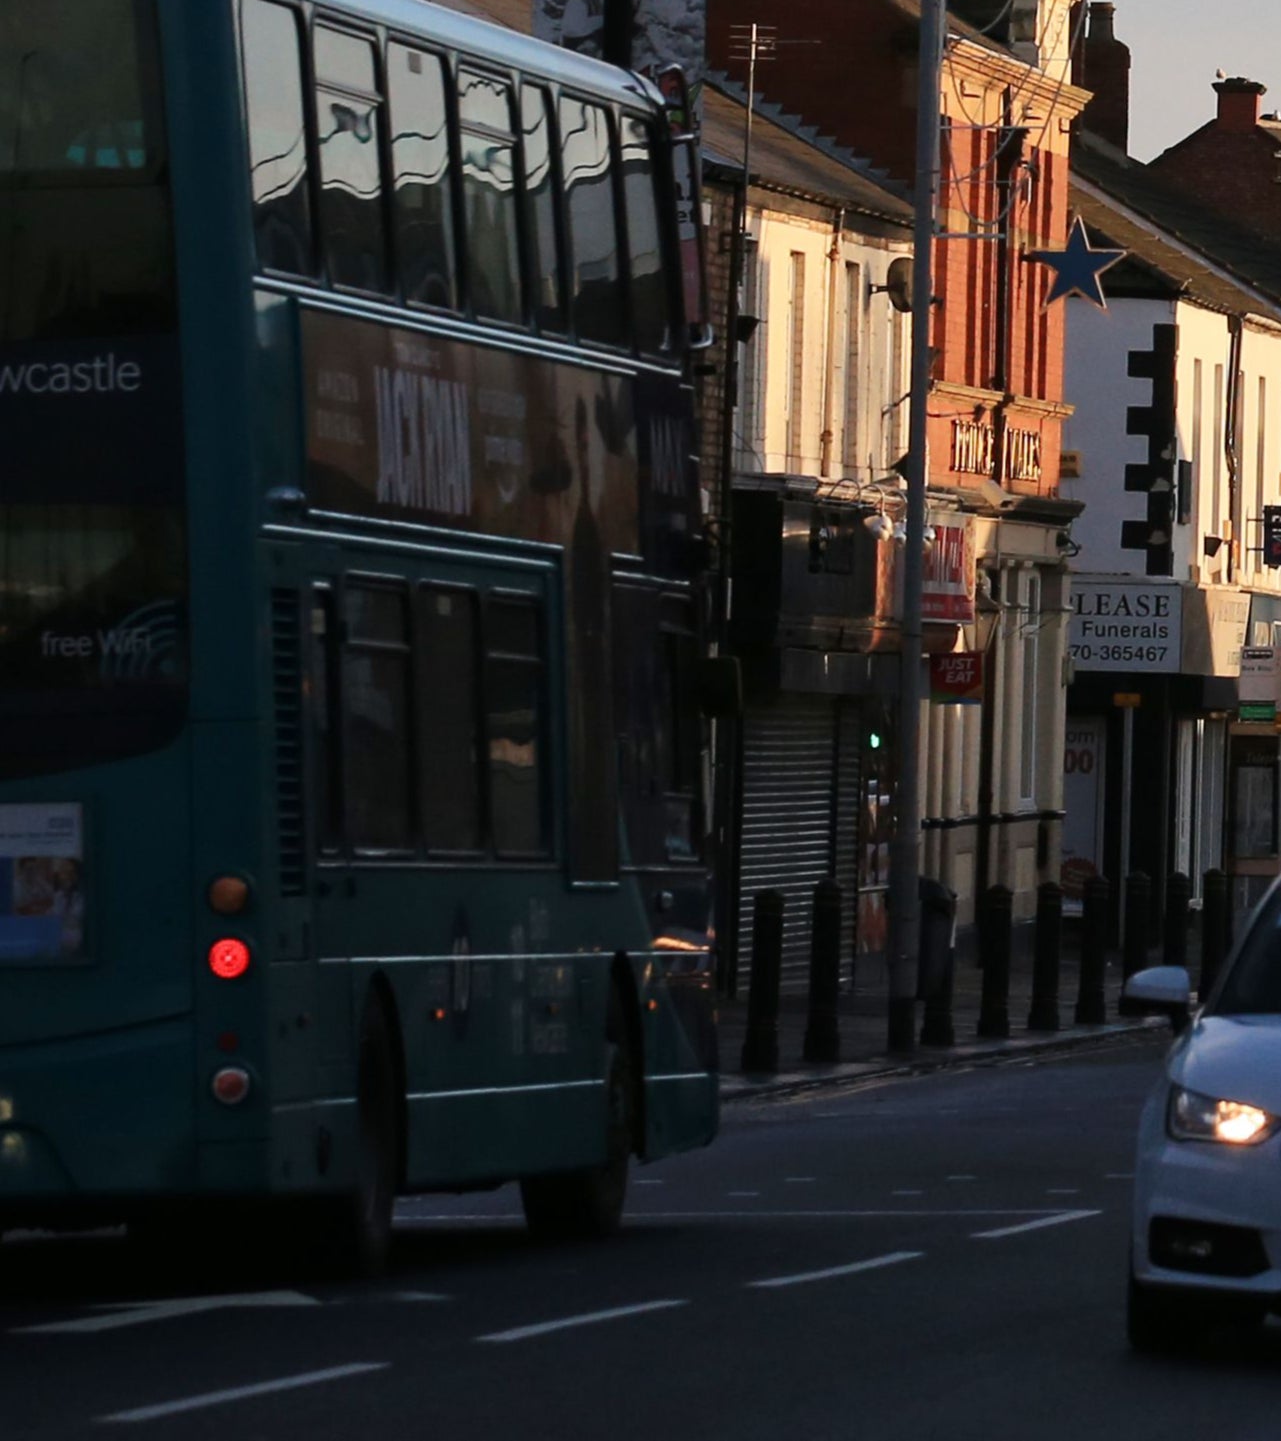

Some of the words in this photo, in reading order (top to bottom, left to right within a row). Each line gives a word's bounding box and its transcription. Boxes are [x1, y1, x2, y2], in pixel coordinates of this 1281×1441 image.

[1069, 593, 1170, 618] LEASE
[1081, 621, 1169, 639] Funerals
[40, 629, 94, 657] free
[938, 657, 975, 672] JUST
[944, 670, 975, 684] EAT
